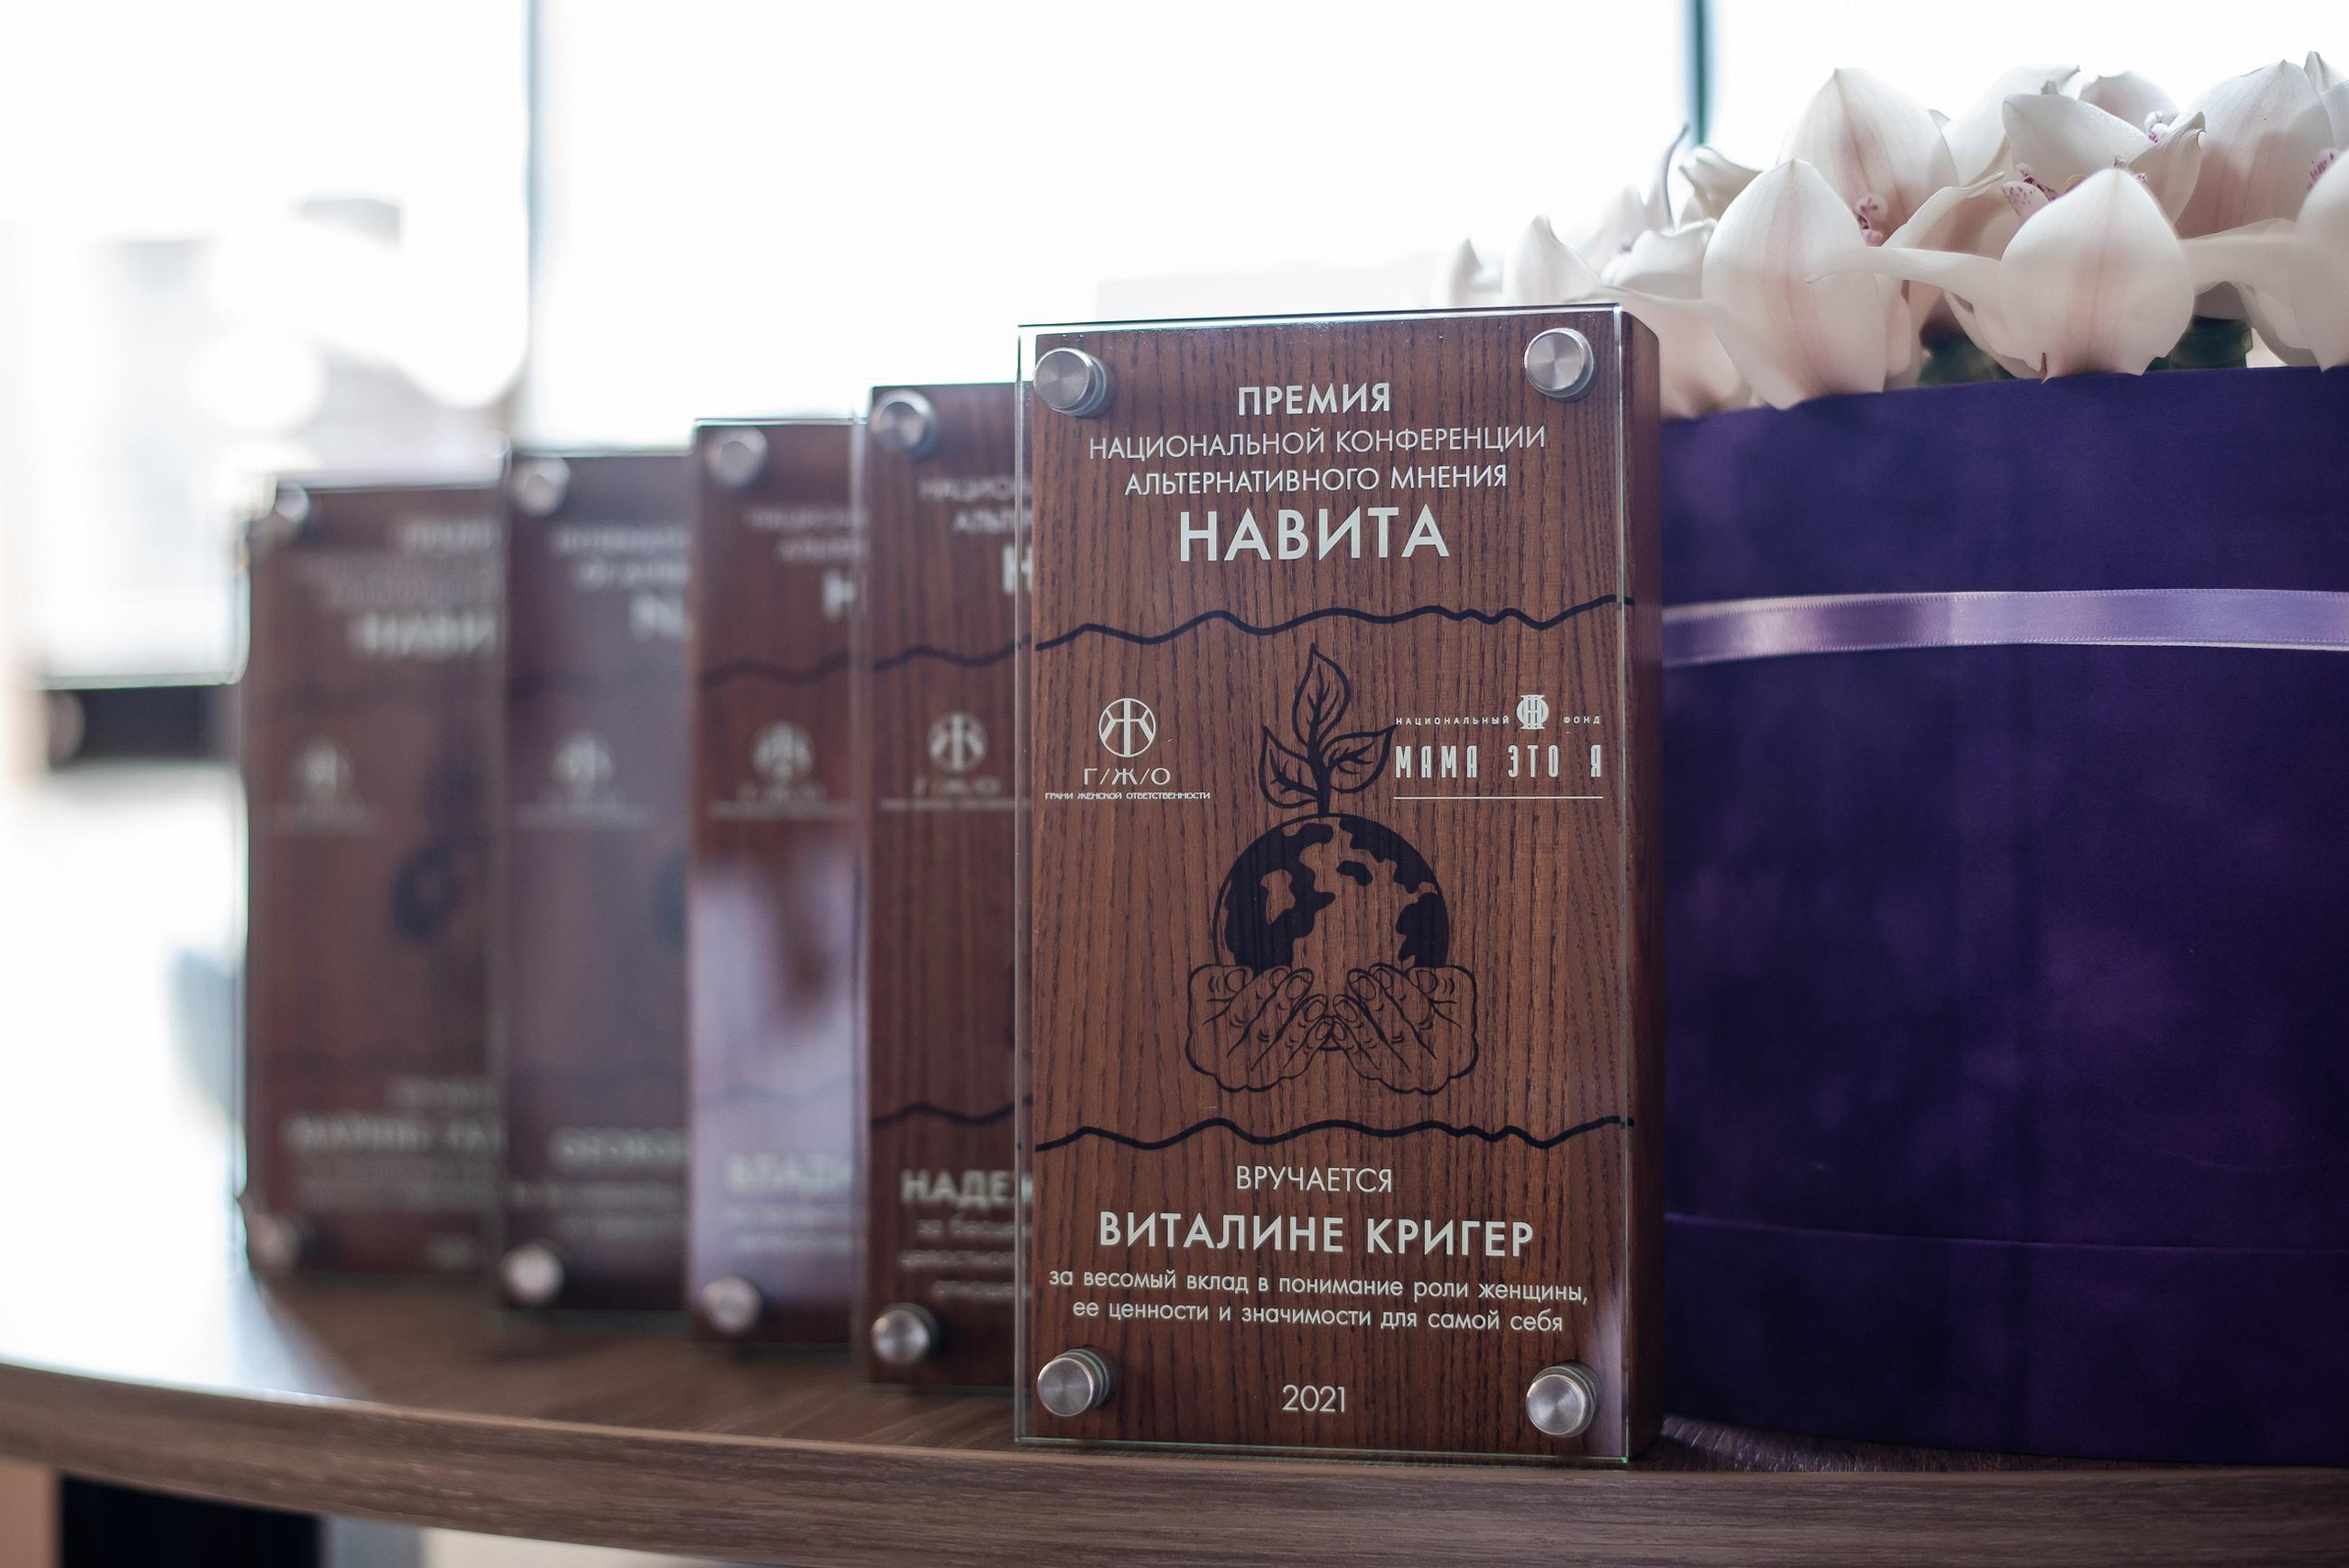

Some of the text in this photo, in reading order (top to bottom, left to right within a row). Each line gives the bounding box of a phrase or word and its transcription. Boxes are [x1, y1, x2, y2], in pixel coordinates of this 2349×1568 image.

[1238, 382, 1390, 417] ПРЕМИЯ
[1089, 425, 1544, 462] НАЦИОНАЛЬНОЙ КОНФЕРЕНЦИИ
[1124, 464, 1507, 495] АЛЬТЕРНАТИВНОГО МНЕНИЯ
[1181, 505, 1449, 562] НАВИТА
[1396, 715, 1601, 727] НАЦИОНАЛЬНЫЙ ФОНД
[1395, 744, 1601, 779] МАМА ЭТО Я
[1044, 791, 1210, 800] ГРАНИ ЖЕНСКОЙ ОТВЕТСТВЕННОСТИ
[1237, 1165, 1392, 1193] ВРУЧАЕТСЯ
[1100, 1211, 1533, 1257] ВИТАЛИНЕ КРИГЕР
[1049, 1269, 1587, 1306] за весомый вклад в понимание роли женщины,
[1073, 1301, 1563, 1331] ее ценности и значимости для самой себя
[1282, 1384, 1345, 1413] 2021
